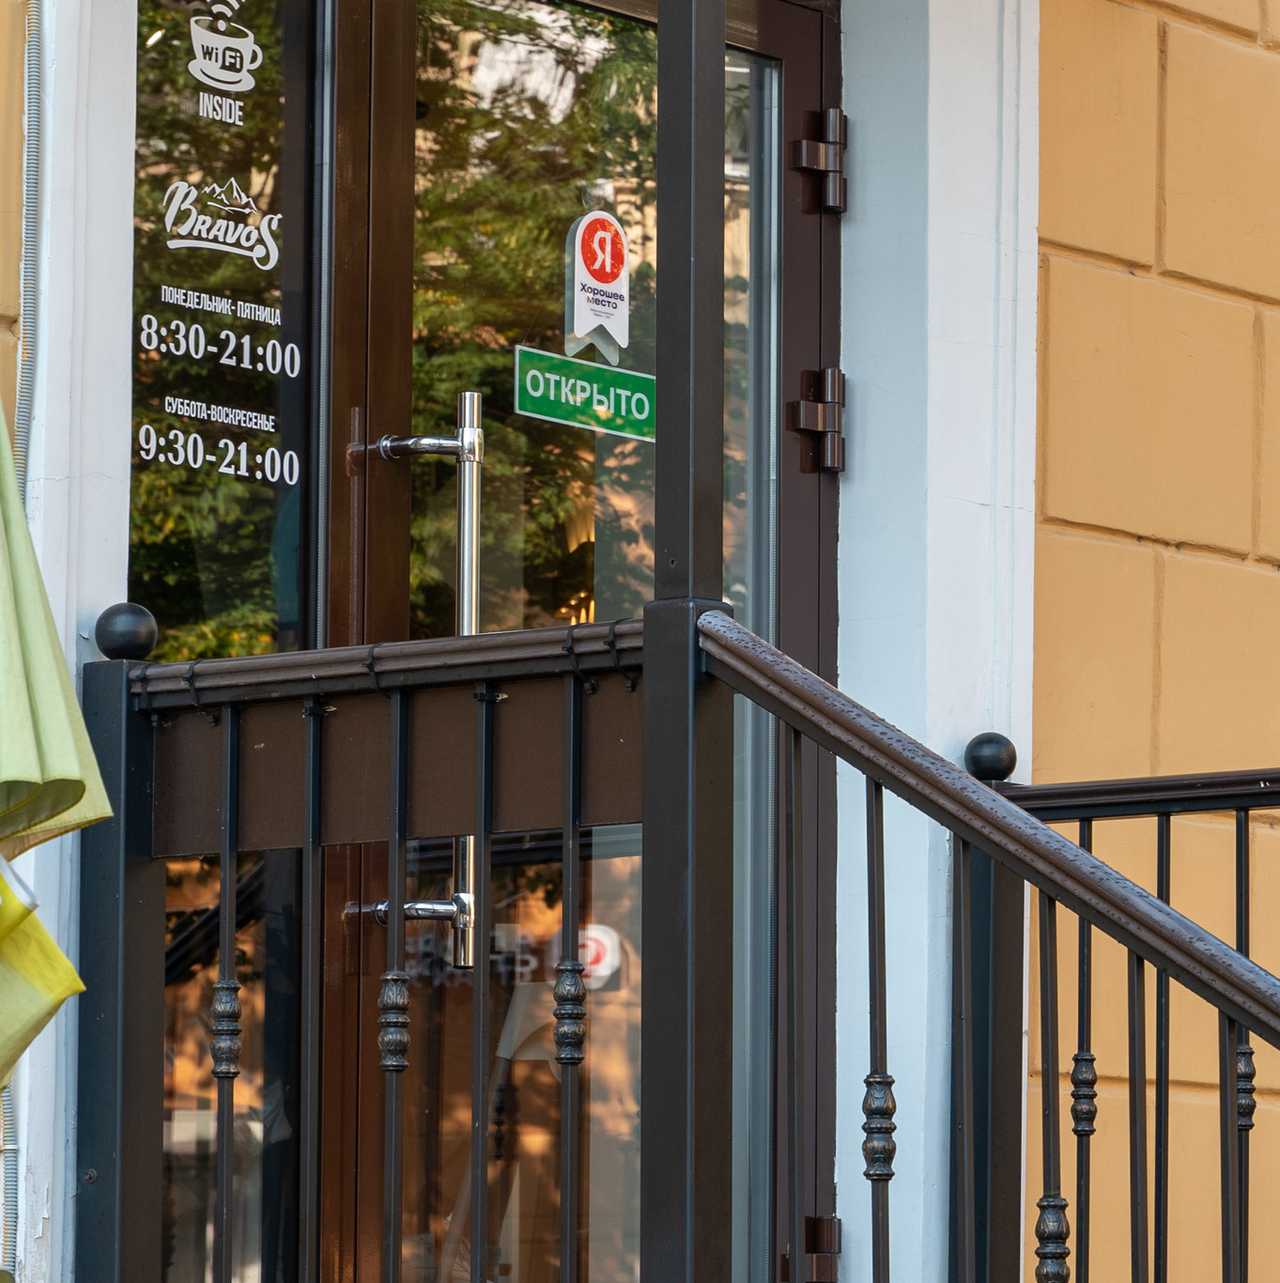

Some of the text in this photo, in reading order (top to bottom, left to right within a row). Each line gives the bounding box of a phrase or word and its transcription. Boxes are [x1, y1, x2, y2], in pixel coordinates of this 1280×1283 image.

[199, 91, 244, 126] INSIDE
[593, 230, 612, 273] Я
[580, 282, 625, 302] Хорошее
[587, 296, 618, 309] место
[140, 314, 300, 378] 8:30-21:00
[526, 369, 650, 420] ОТКРЫТО
[139, 424, 299, 486] 9:30-21:00
